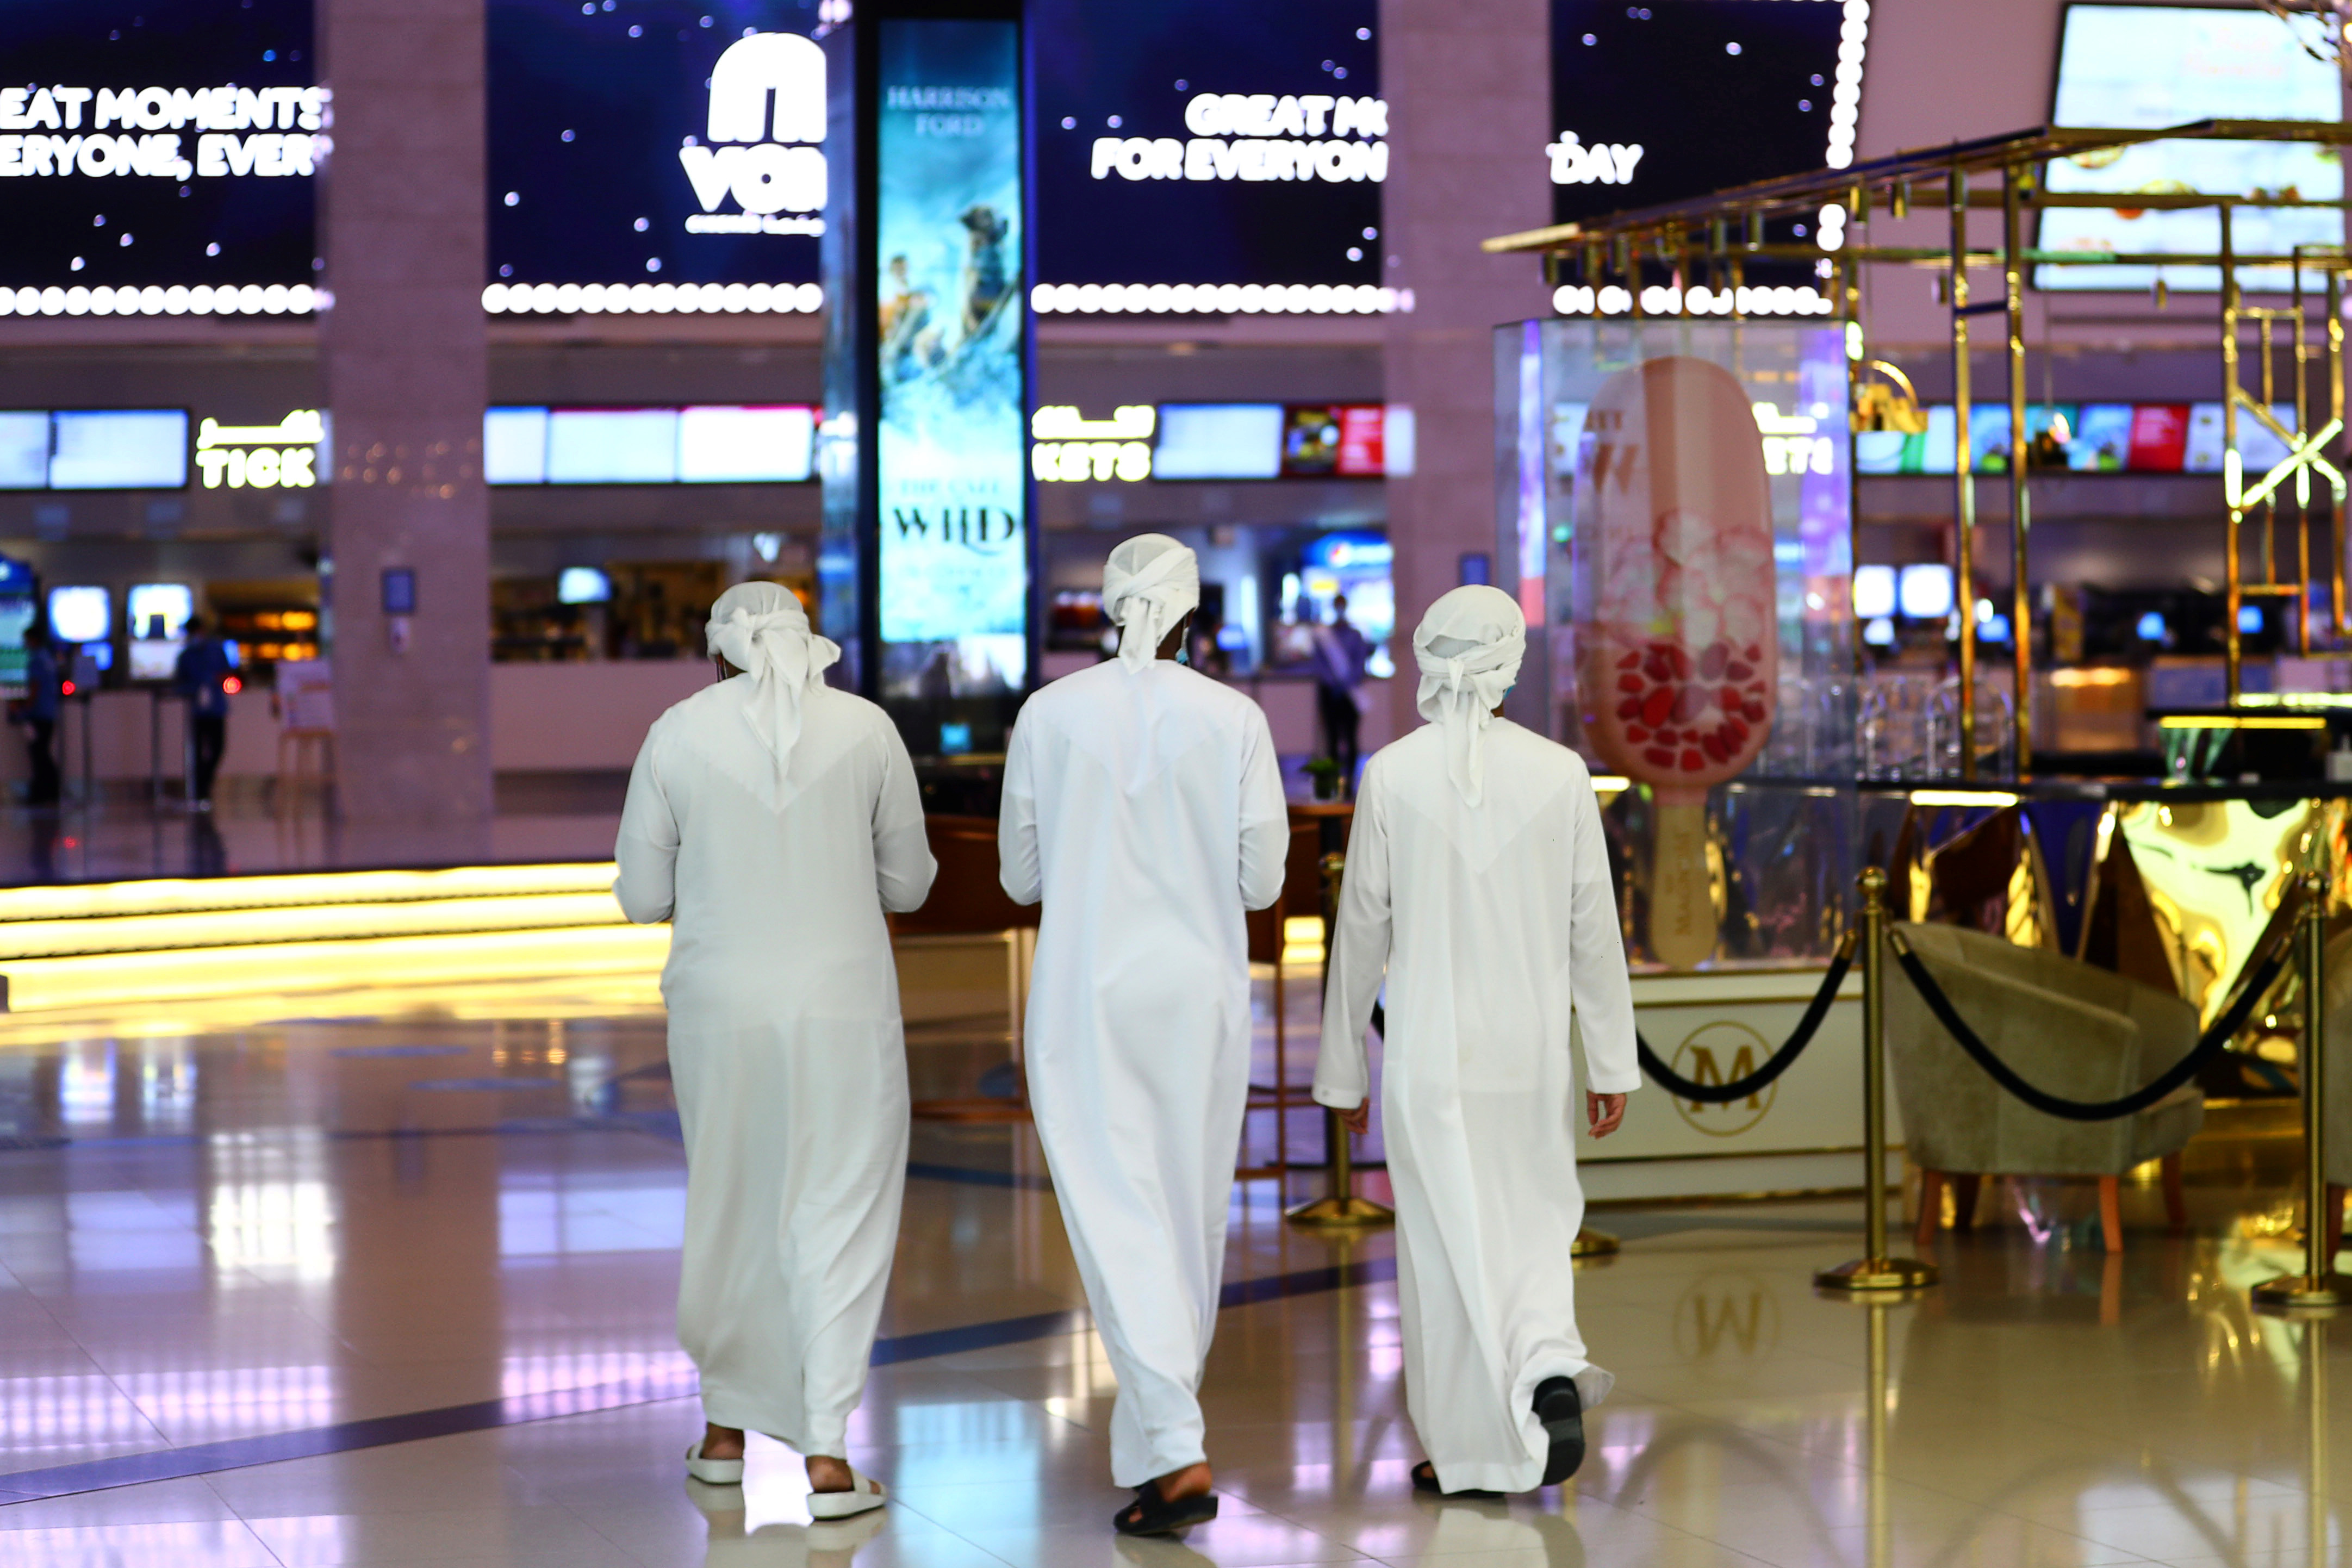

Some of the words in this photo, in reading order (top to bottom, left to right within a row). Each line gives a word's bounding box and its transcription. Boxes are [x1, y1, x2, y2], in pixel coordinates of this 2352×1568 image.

[0, 86, 92, 129] EAT
[915, 113, 985, 138] FORD
[1185, 93, 1336, 136] GREAT
[1091, 137, 1184, 181] FOR
[1551, 143, 1644, 185] DAY
[195, 447, 316, 488] TICK
[893, 506, 1016, 556] WILD
[1690, 1045, 1760, 1113] M
